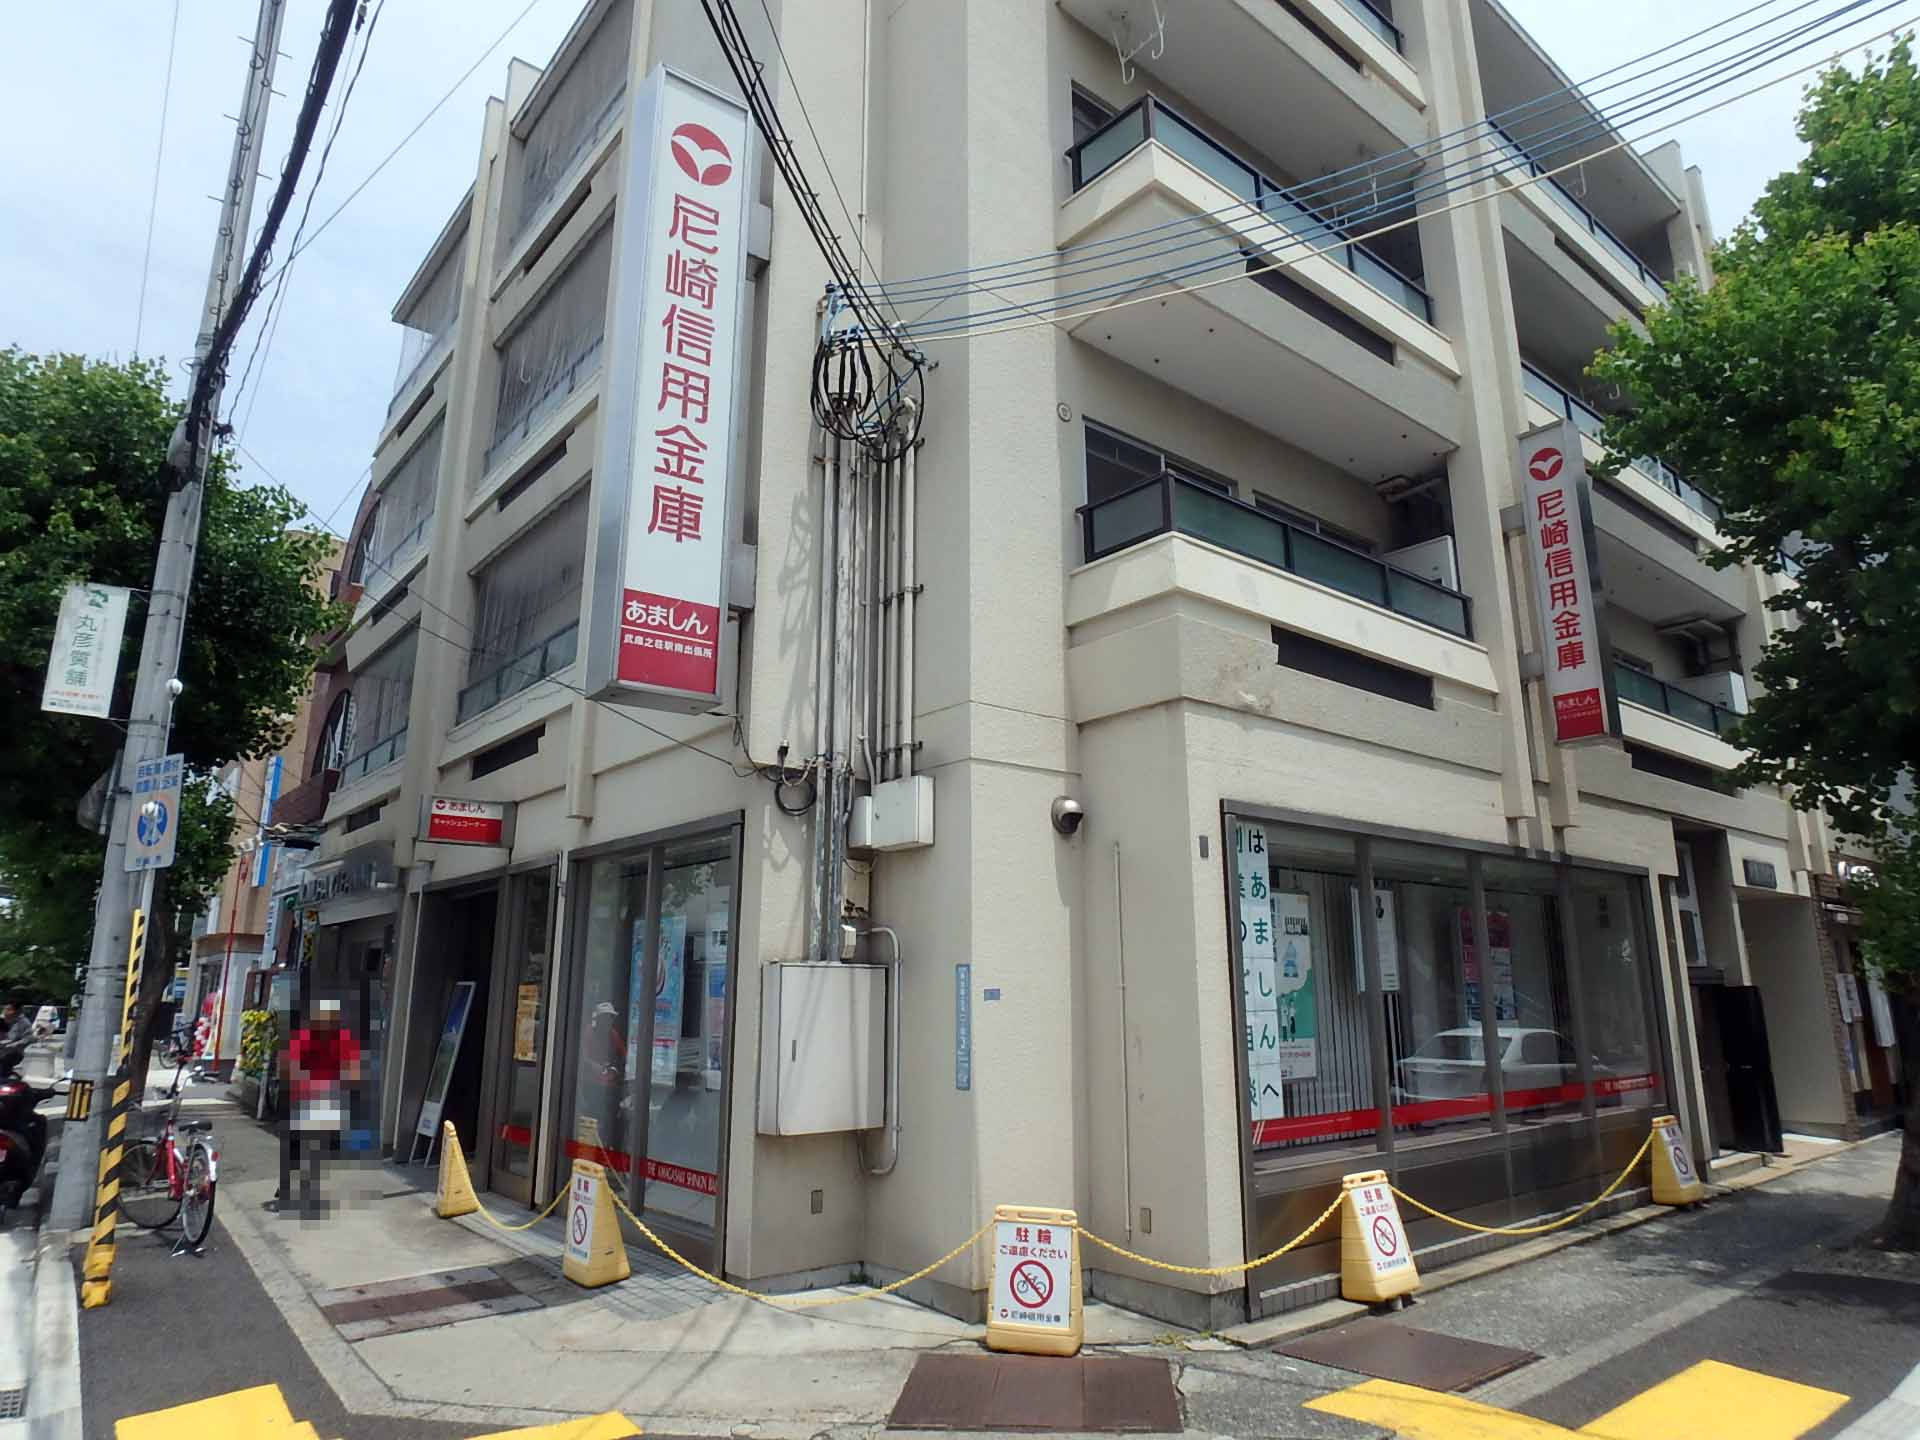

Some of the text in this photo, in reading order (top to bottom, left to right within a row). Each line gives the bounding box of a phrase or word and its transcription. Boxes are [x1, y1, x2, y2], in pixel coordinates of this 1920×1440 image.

[648, 192, 721, 543] 尼崎信用金庫
[1537, 489, 1586, 673] 尼崎信用金庫
[625, 600, 709, 635] あましん
[1000, 1244, 1068, 1259] ご遠慮ください
[1015, 1227, 1052, 1245] 駐輪
